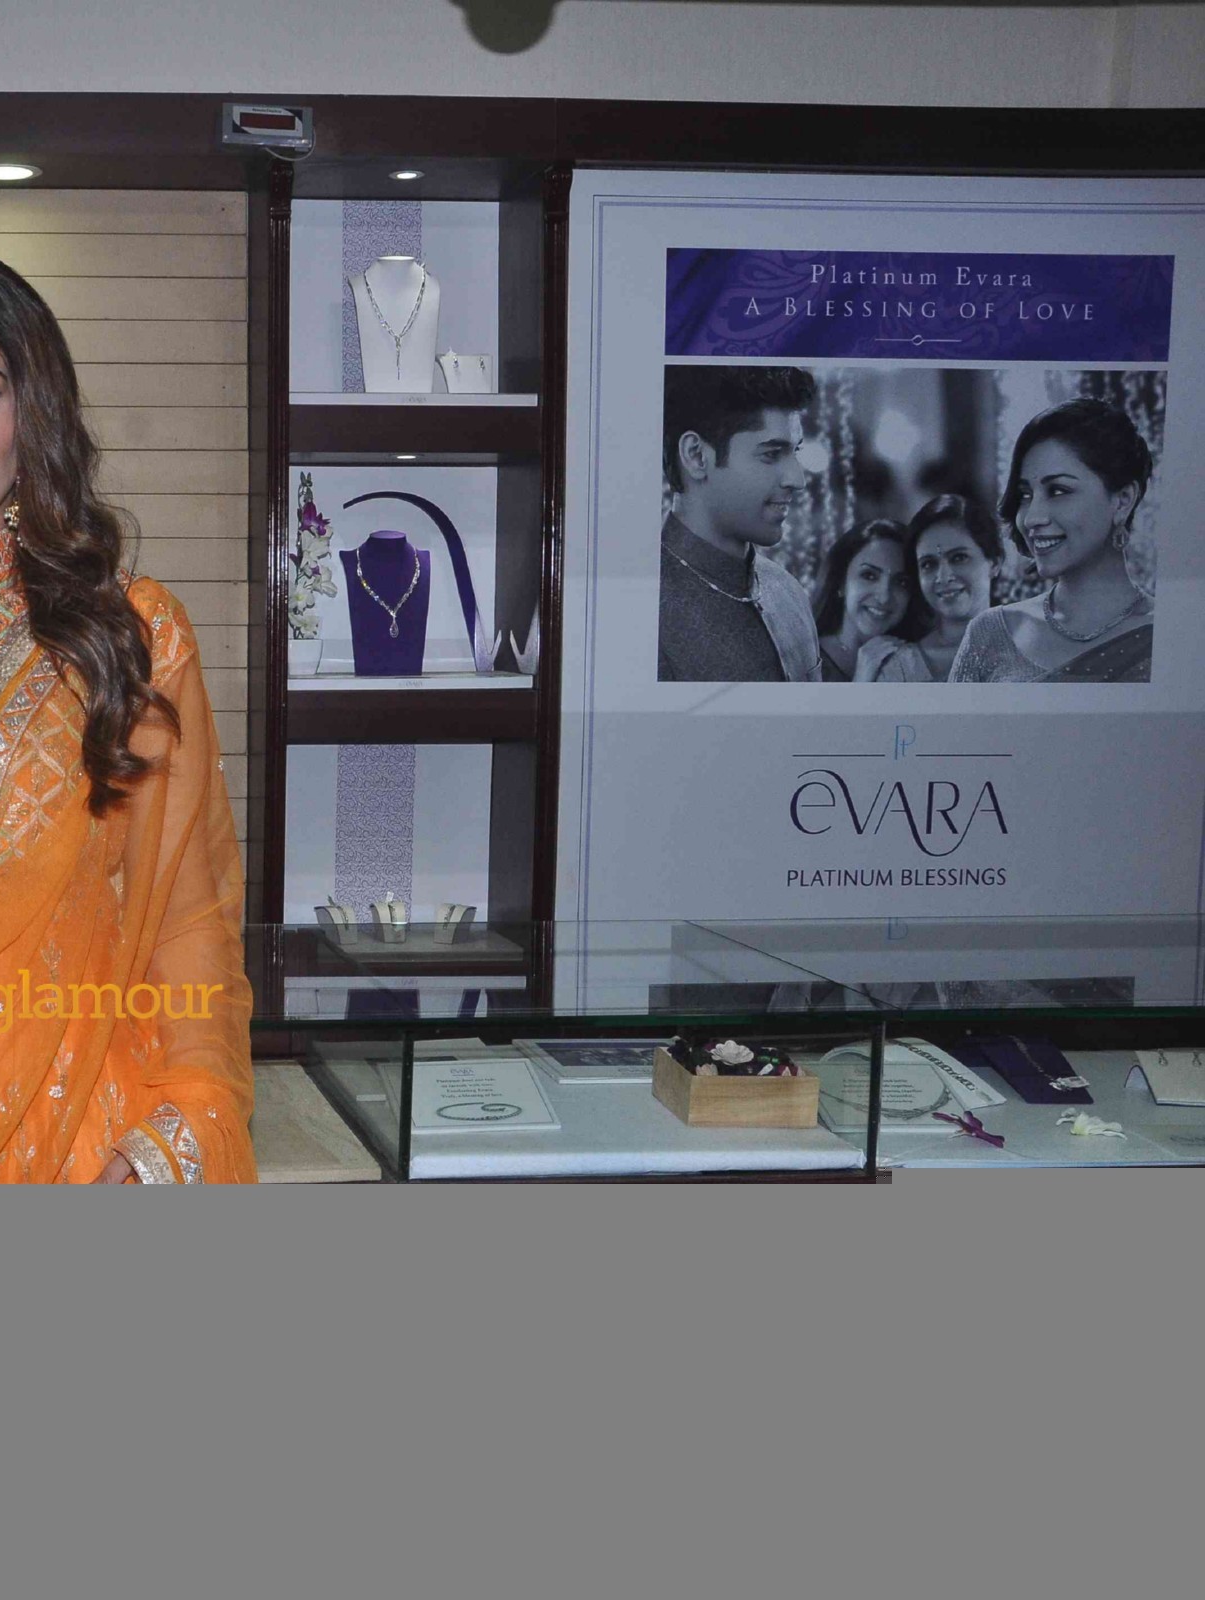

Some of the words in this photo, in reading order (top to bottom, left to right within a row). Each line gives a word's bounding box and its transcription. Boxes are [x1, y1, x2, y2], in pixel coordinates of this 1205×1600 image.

[810, 264, 938, 286] Platinum
[955, 266, 1032, 287] Evara
[745, 297, 760, 316] A
[784, 297, 936, 318] BLESSING
[959, 301, 995, 319] OF
[1018, 301, 1094, 321] LOVE
[787, 869, 893, 887] PLATINUM
[900, 868, 1007, 886] BLESSINGS
